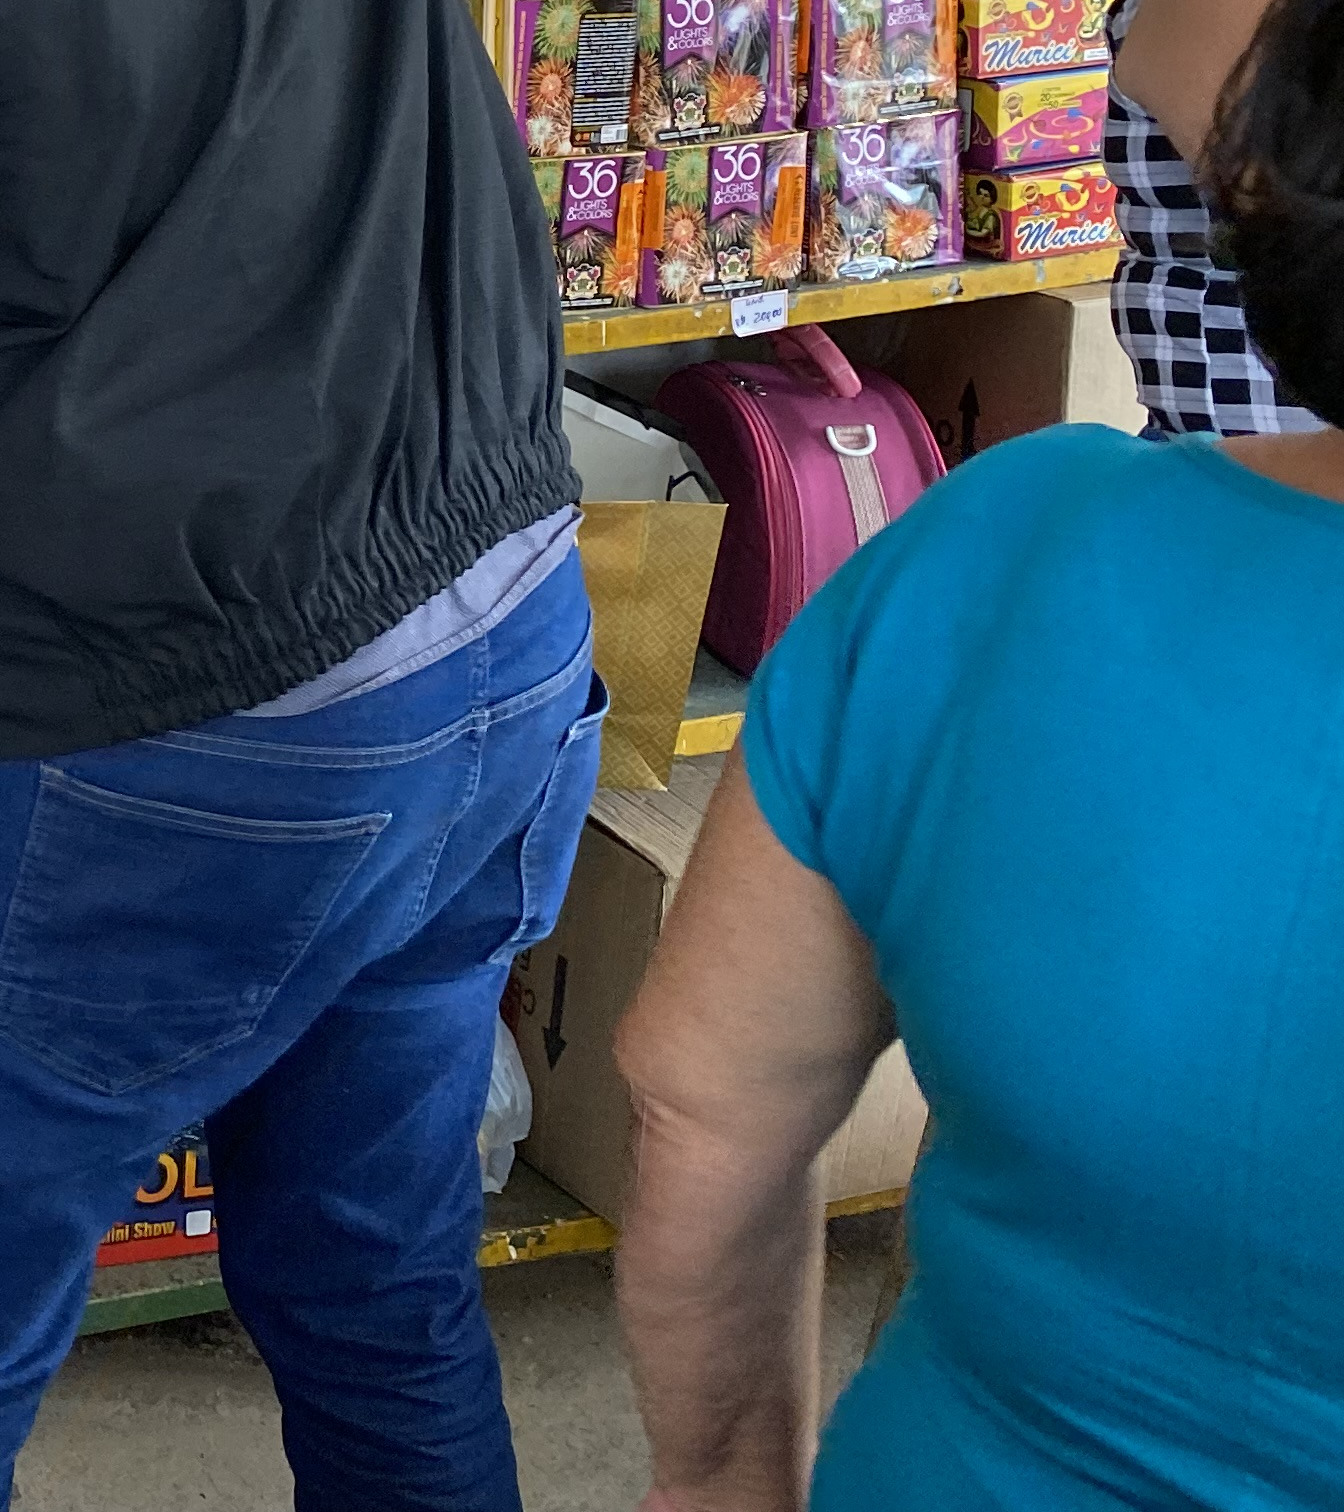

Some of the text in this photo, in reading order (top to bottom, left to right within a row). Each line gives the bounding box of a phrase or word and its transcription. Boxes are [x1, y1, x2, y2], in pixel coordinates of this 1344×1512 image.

[675, 27, 709, 39] LIGHTS
[983, 37, 1077, 71] Murici
[568, 160, 618, 198] 36
[714, 145, 761, 183] 36
[1016, 218, 1113, 251] Murici
